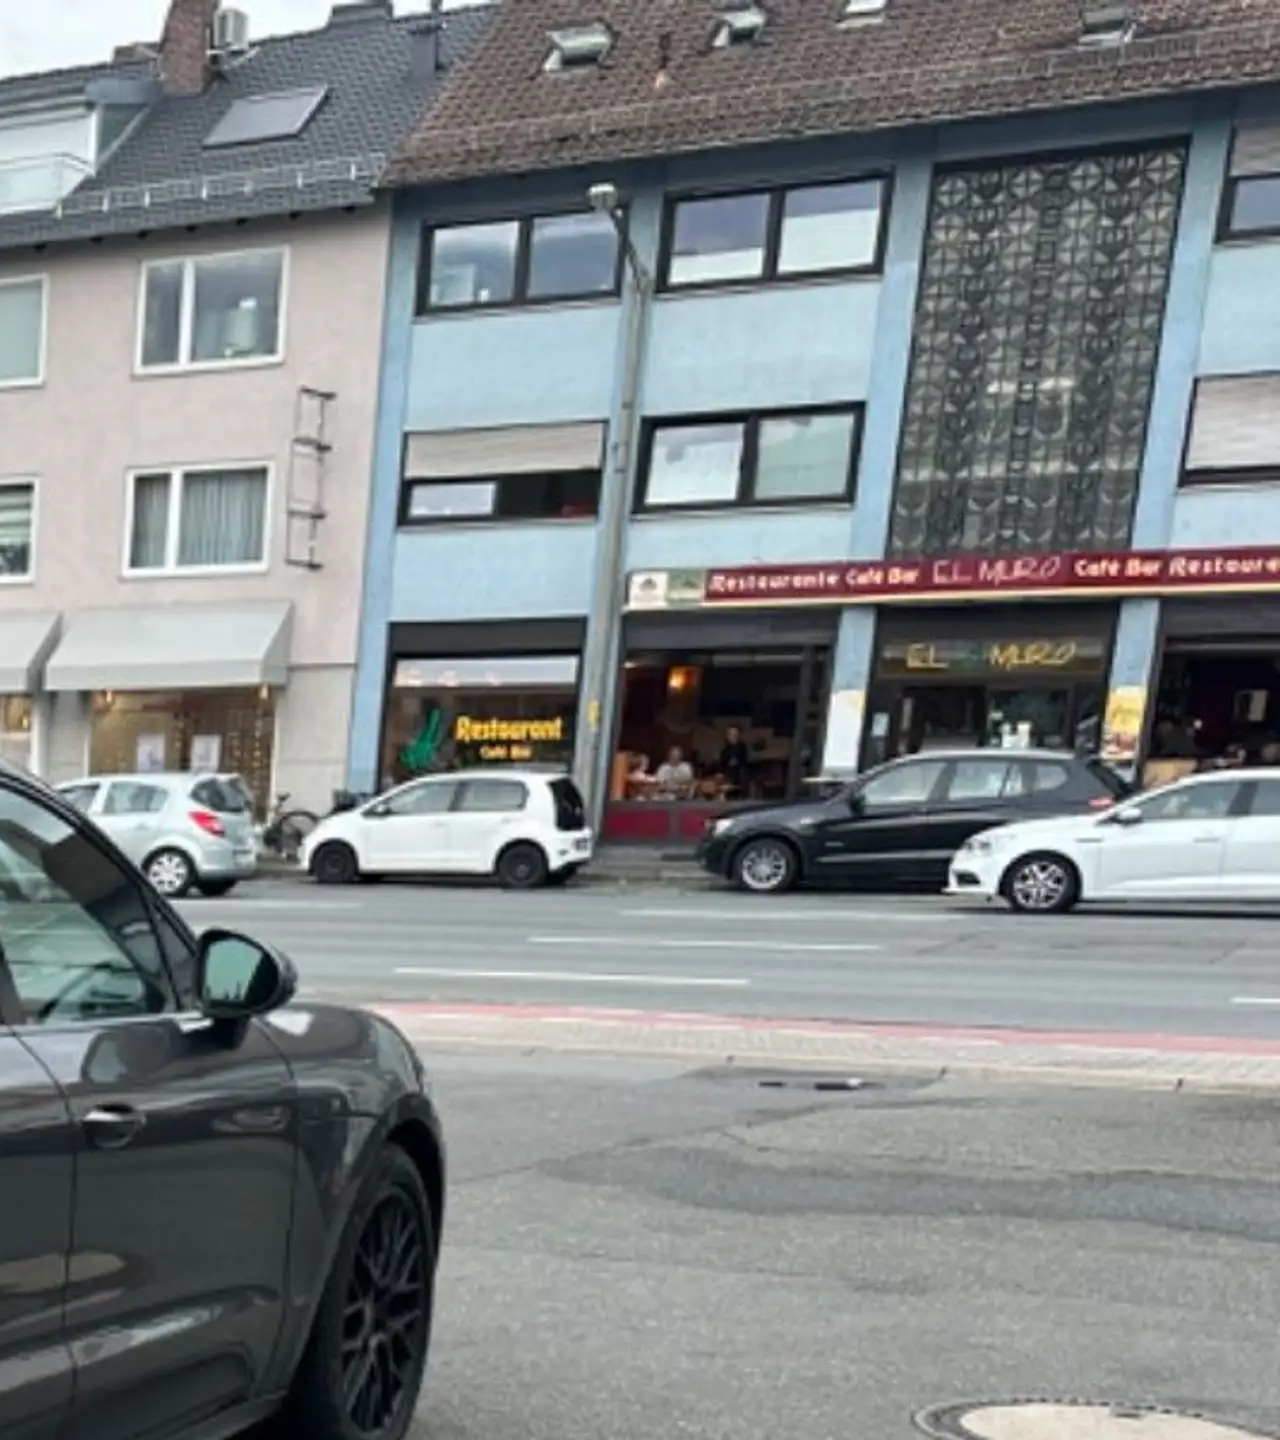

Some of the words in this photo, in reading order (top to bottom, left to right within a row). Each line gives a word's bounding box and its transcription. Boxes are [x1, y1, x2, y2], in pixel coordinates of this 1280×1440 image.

[708, 571, 840, 593] Restaurante
[888, 565, 920, 584] Bar
[932, 561, 972, 584] EL
[1124, 557, 1162, 577] Bar
[906, 643, 948, 668] EL
[455, 715, 563, 741] Restaurant
